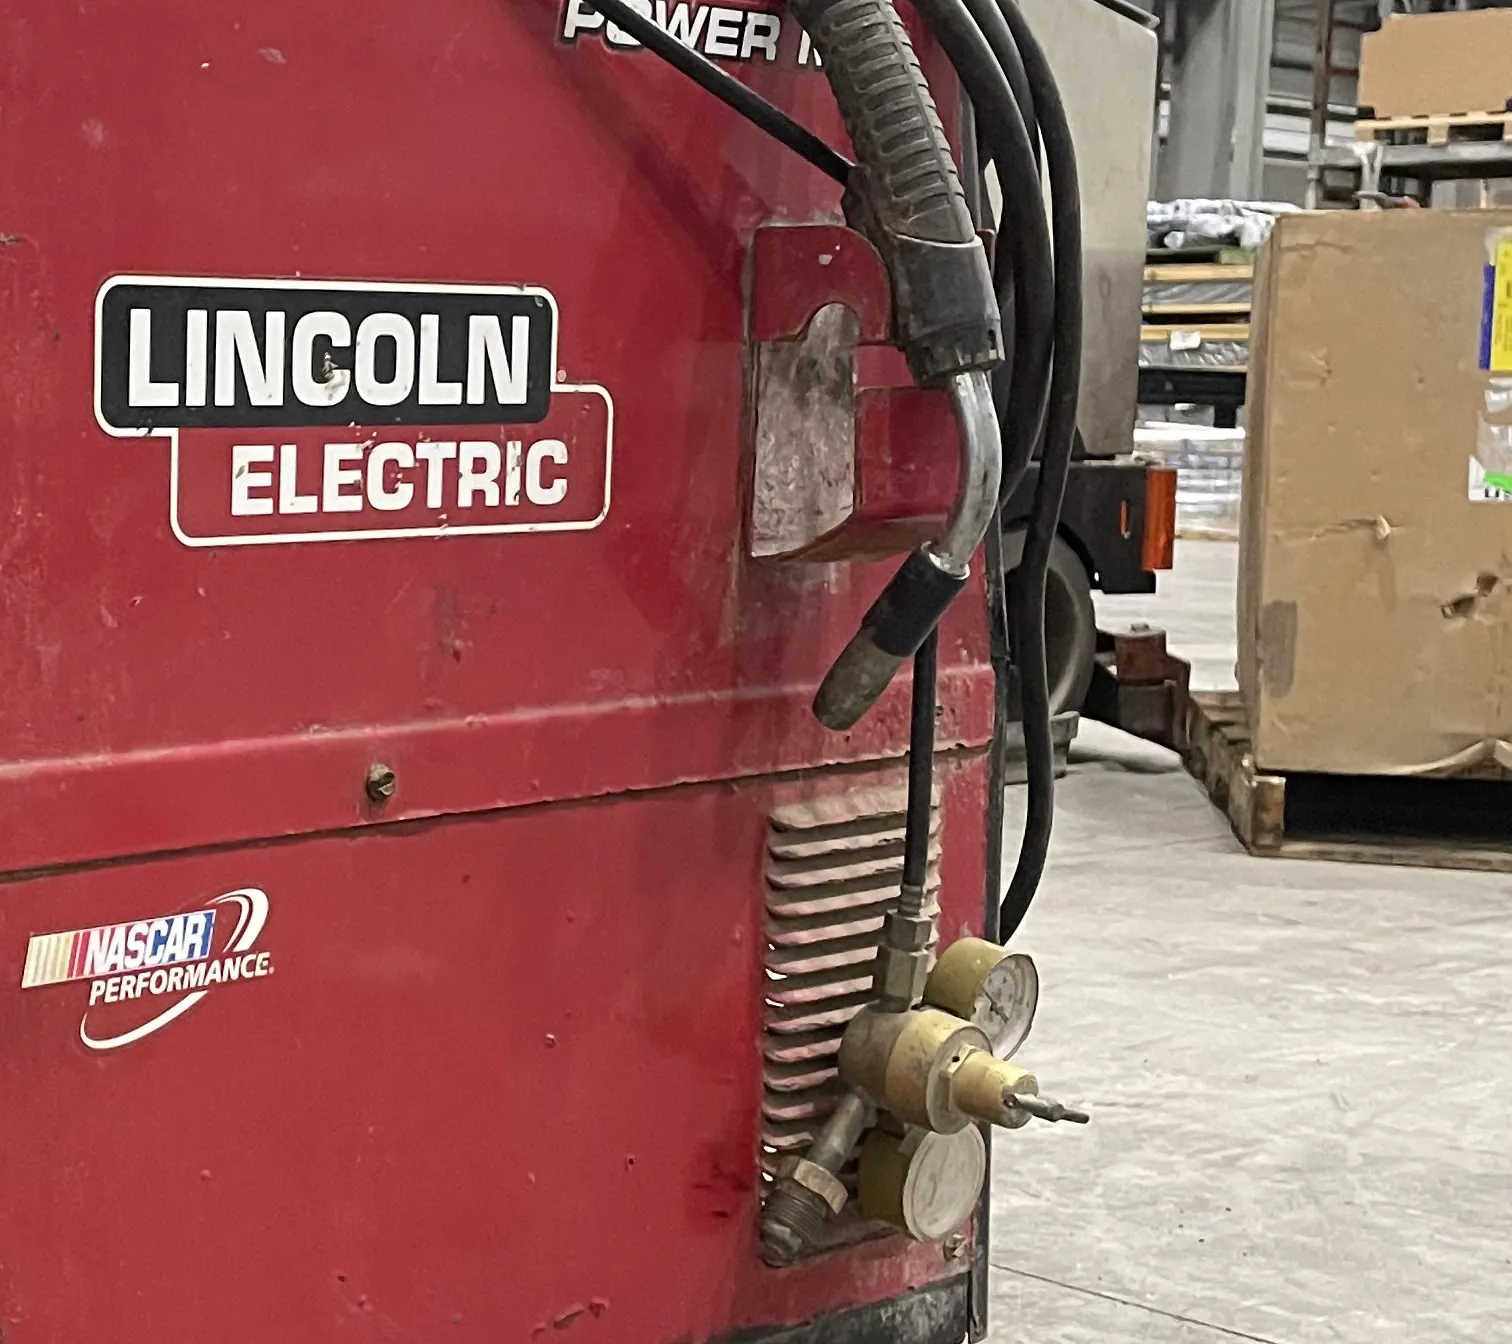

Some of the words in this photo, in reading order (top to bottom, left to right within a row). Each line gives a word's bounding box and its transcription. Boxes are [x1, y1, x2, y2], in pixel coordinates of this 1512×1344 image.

[127, 307, 531, 409] LINCOLN
[230, 438, 569, 517] ELECTRIC
[85, 913, 208, 976] NASCAR
[88, 952, 272, 1007] PERFORMANCE
